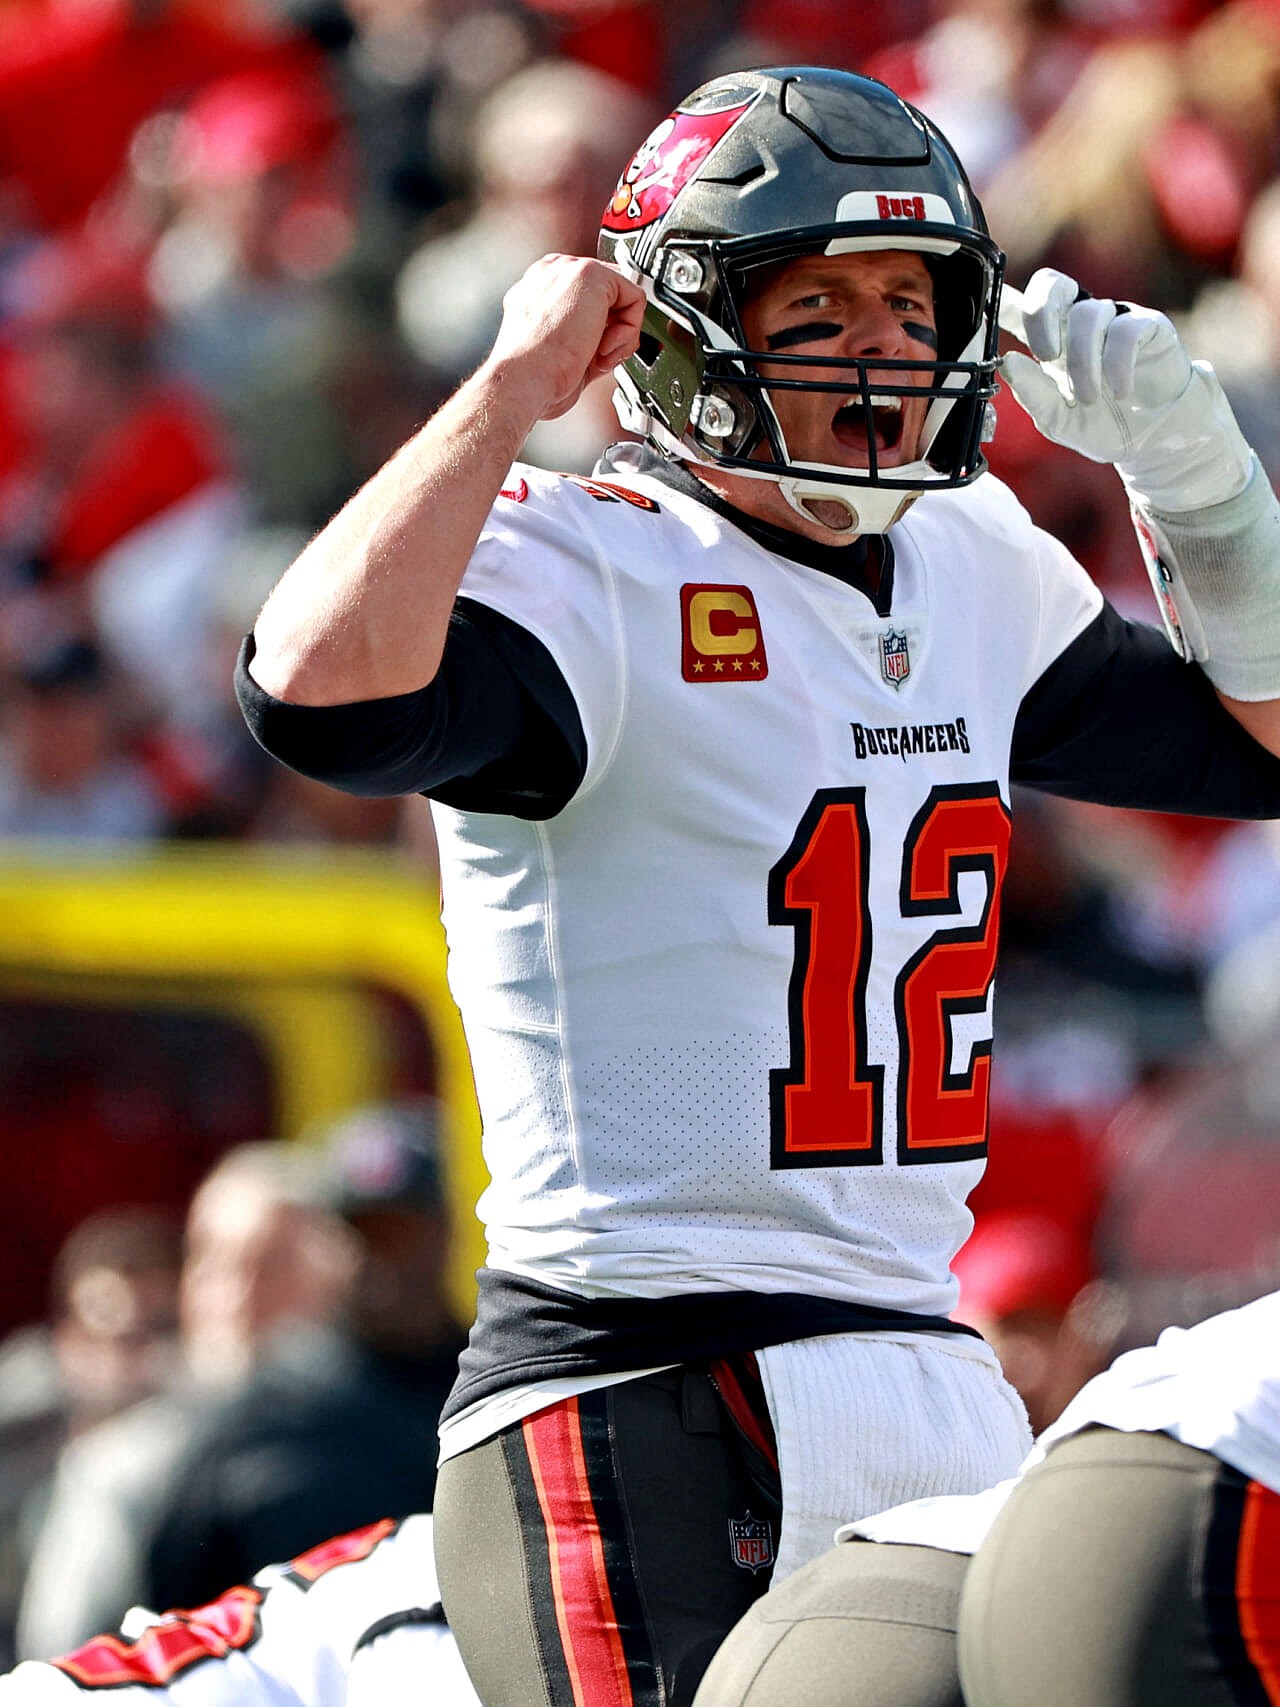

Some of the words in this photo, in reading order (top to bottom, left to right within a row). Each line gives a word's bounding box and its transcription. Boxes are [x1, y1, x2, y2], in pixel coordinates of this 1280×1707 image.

[688, 591, 758, 656] C
[887, 653, 910, 678] NFL
[850, 716, 971, 764] BUCCANEERS
[766, 779, 1013, 1171] 12
[737, 1539, 769, 1564] NFL
